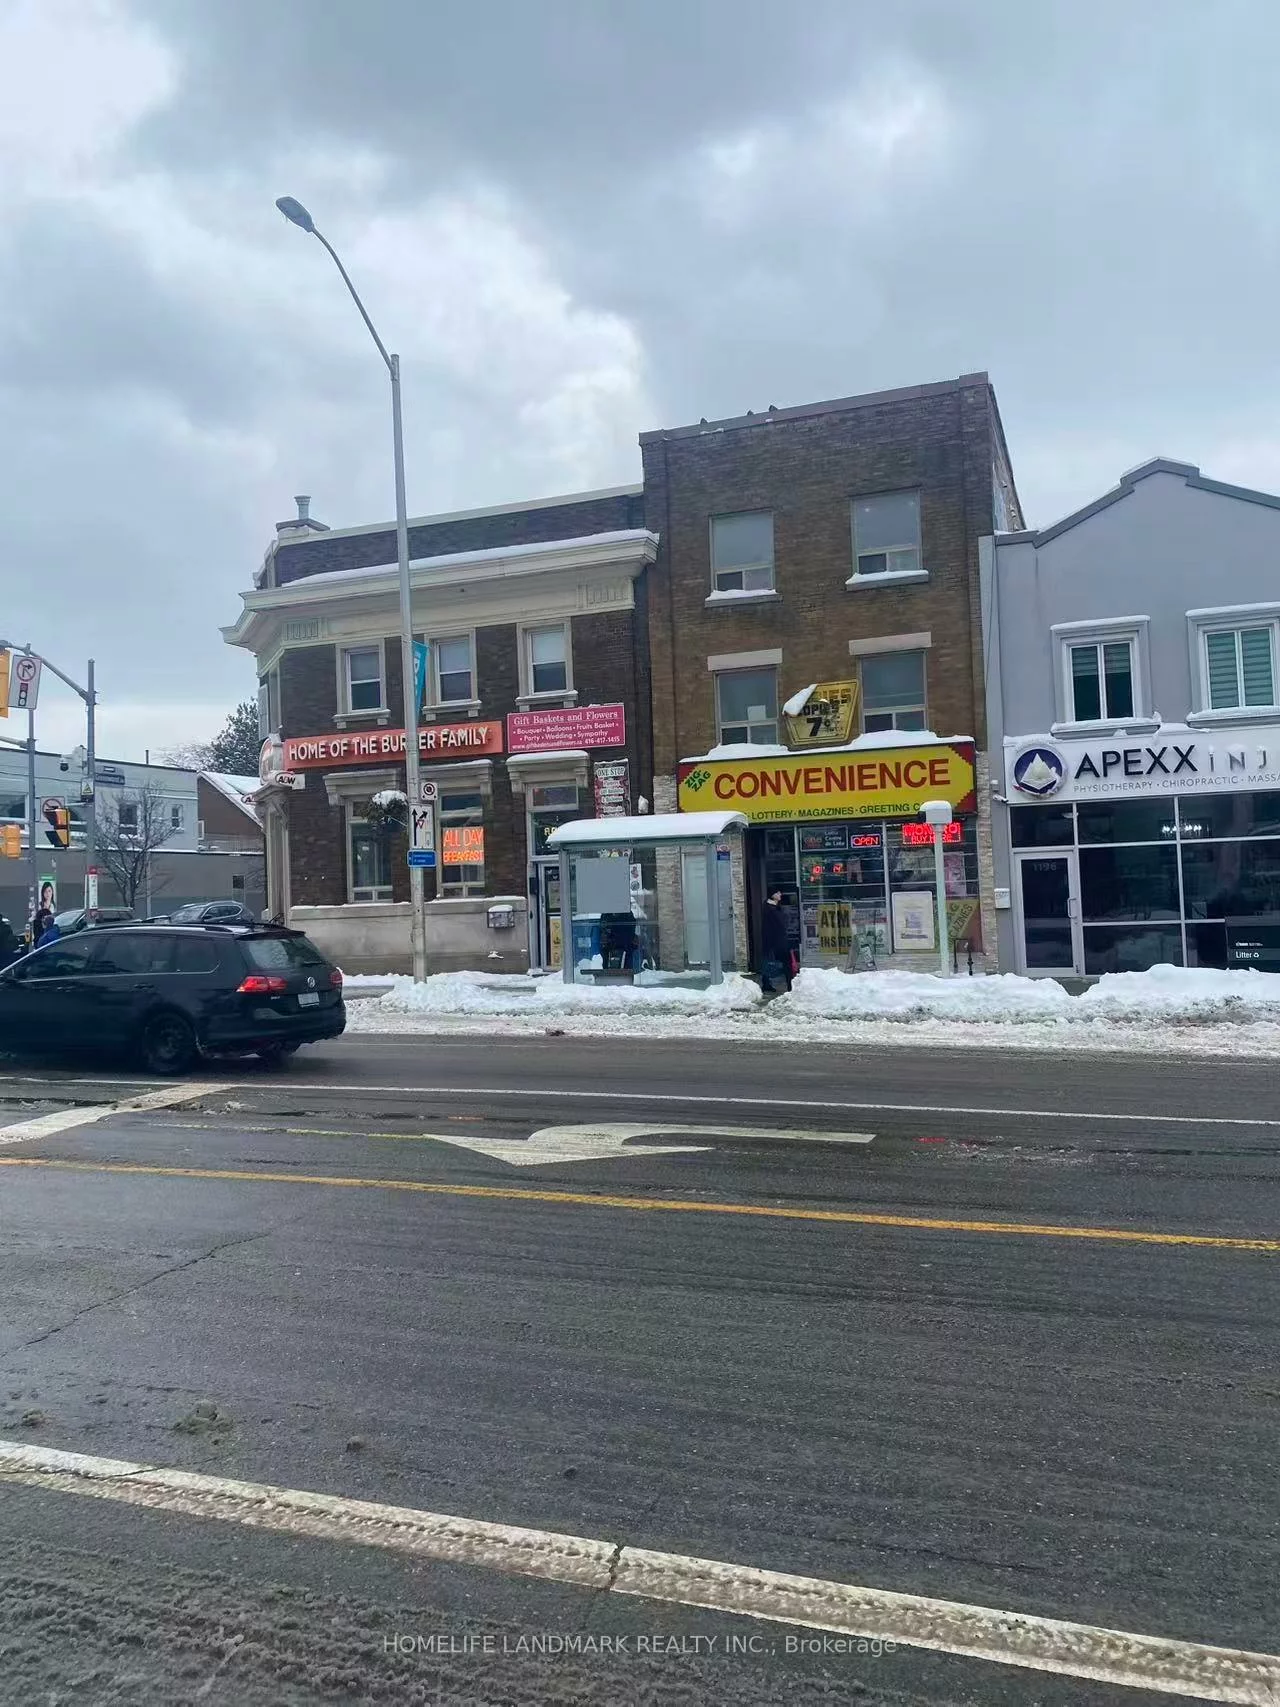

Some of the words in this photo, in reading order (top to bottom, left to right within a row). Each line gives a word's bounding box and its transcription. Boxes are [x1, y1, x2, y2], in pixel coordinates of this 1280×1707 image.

[513, 716, 530, 726] Gift
[533, 714, 564, 724] Baskets
[567, 712, 583, 722] and
[586, 710, 618, 720] Flowers
[546, 725, 573, 733] Balloons
[594, 721, 615, 729] Basket
[289, 741, 326, 761] HOME
[330, 738, 348, 758] OF
[352, 735, 377, 756] THE
[381, 731, 436, 752] BURER
[440, 727, 489, 749] FAMILY
[523, 735, 541, 743] Party
[545, 732, 573, 741] Wedding
[577, 730, 608, 739] Sympathy
[1074, 744, 1198, 779] APEXX
[714, 758, 951, 800] CONVENIENCE
[1073, 780, 1154, 793] PHYSIOTHERAPY
[1162, 775, 1238, 788] CHIROPRACTIC
[751, 809, 793, 820] LOTTERY
[798, 806, 854, 817] MAGAZINES
[859, 803, 910, 814] GREETING
[444, 829, 461, 847] ALL
[463, 828, 484, 846] DAY
[853, 836, 879, 846] OPEN
[930, 833, 952, 844] HRE
[820, 910, 850, 929] ATM
